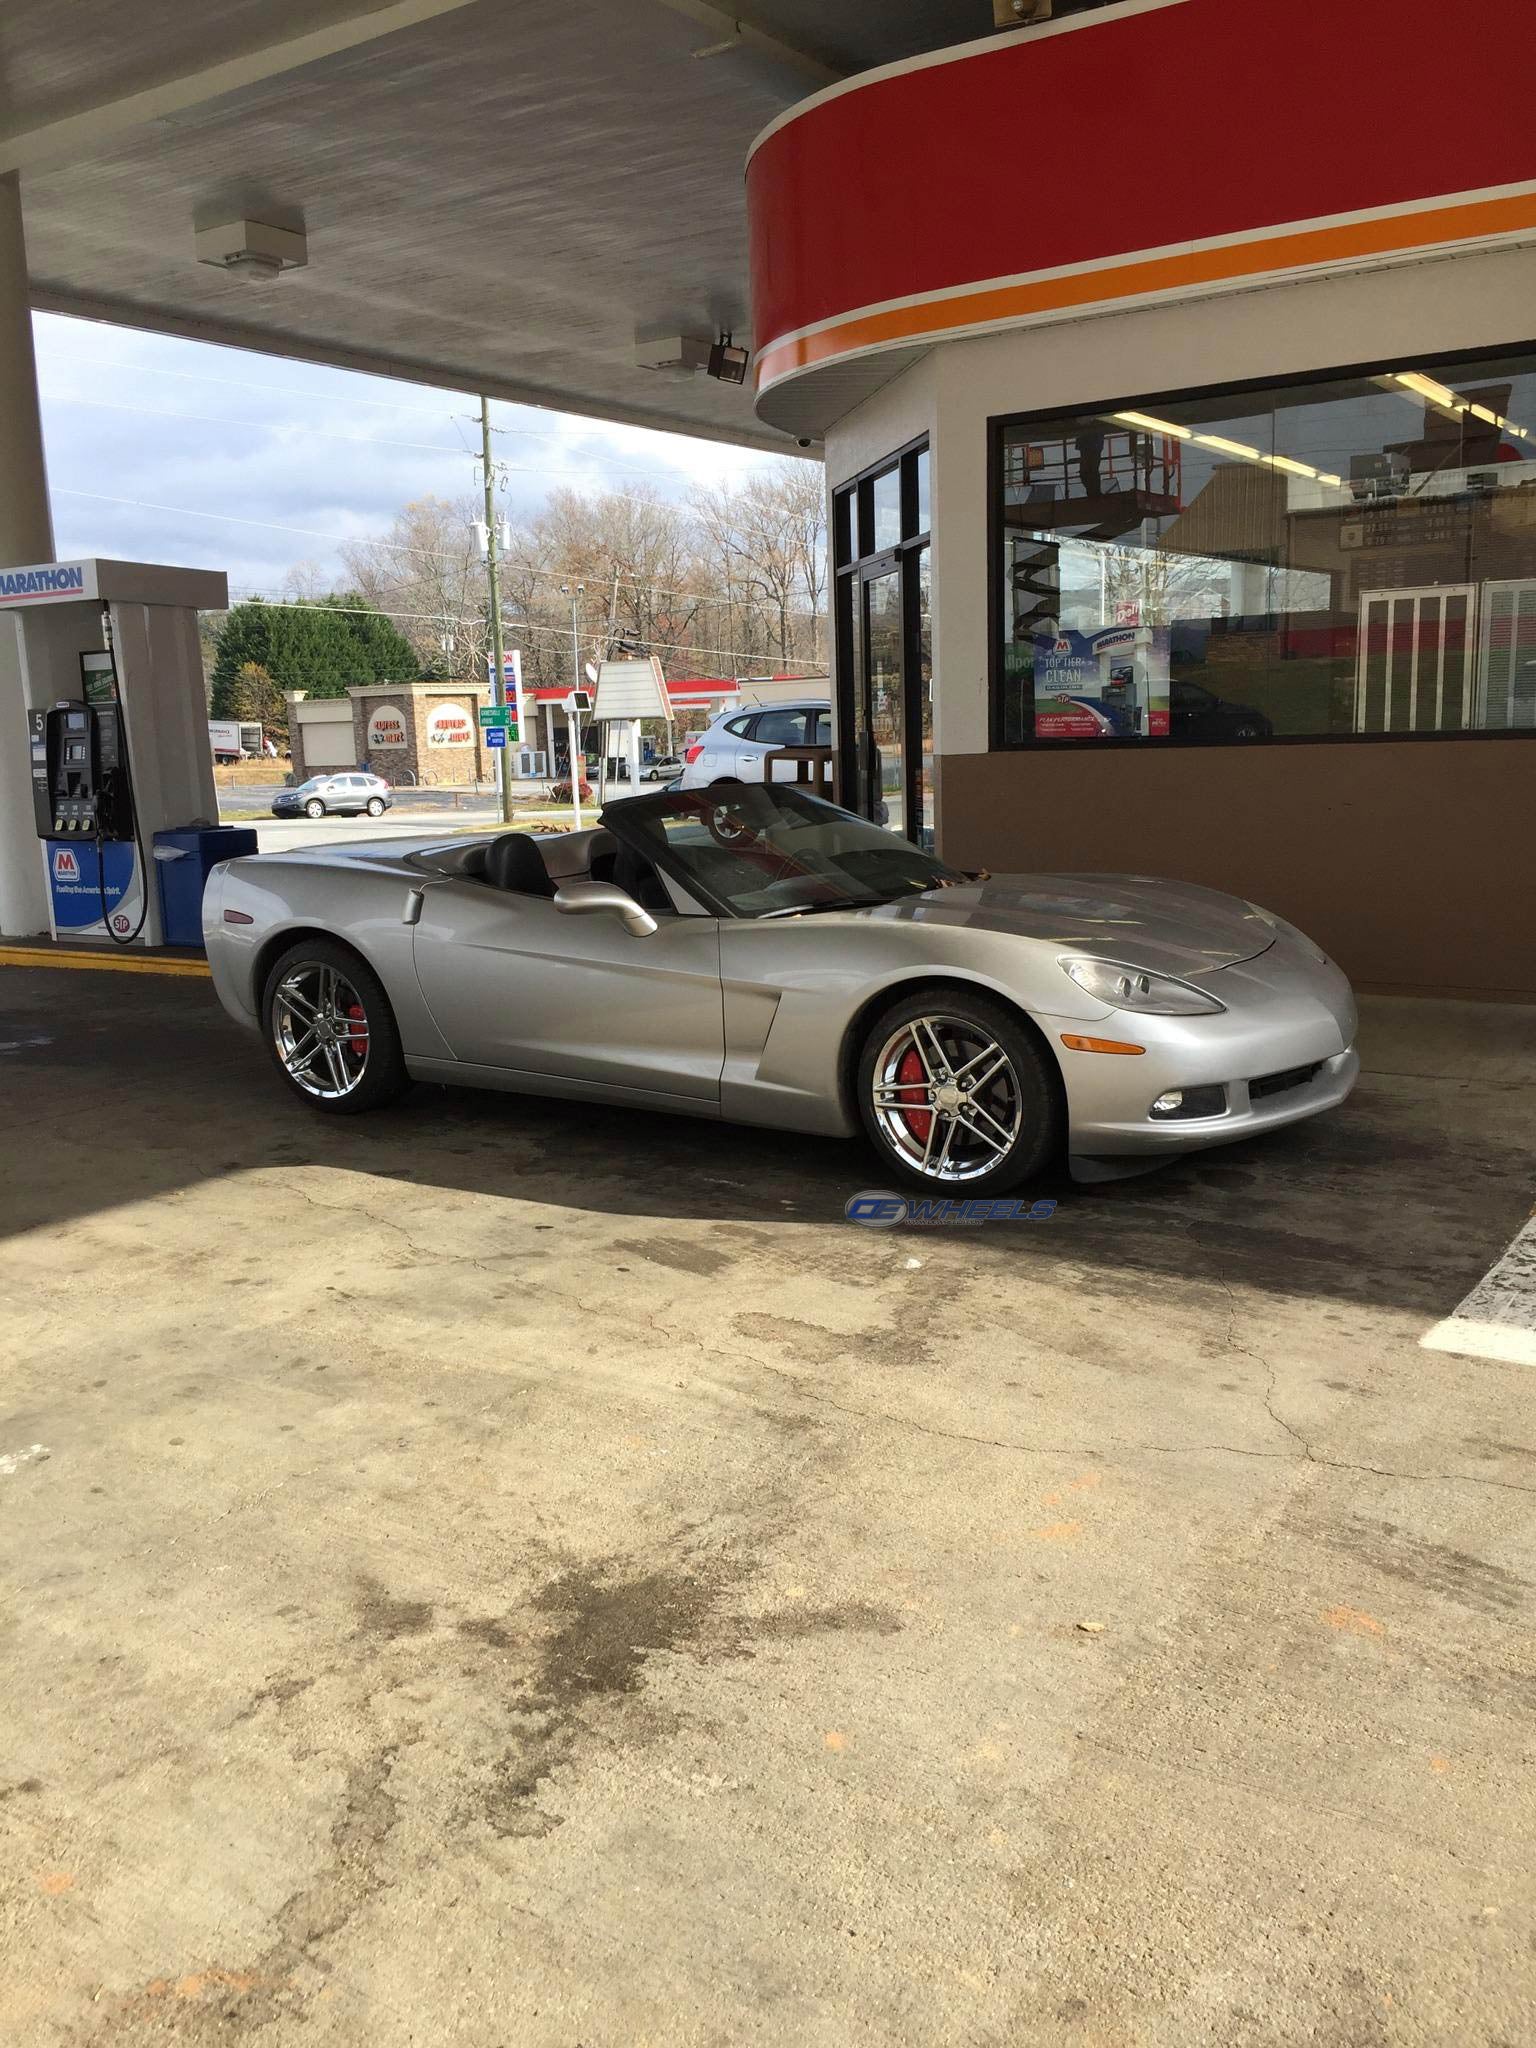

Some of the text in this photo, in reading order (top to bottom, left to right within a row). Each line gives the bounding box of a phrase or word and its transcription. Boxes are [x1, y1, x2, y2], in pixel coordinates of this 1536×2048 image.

[1045, 656, 1081, 669] TOP TIER
[1046, 668, 1081, 683] CLEAN
[35, 713, 44, 731] 5
[57, 854, 75, 870] M
[114, 916, 129, 931] STP
